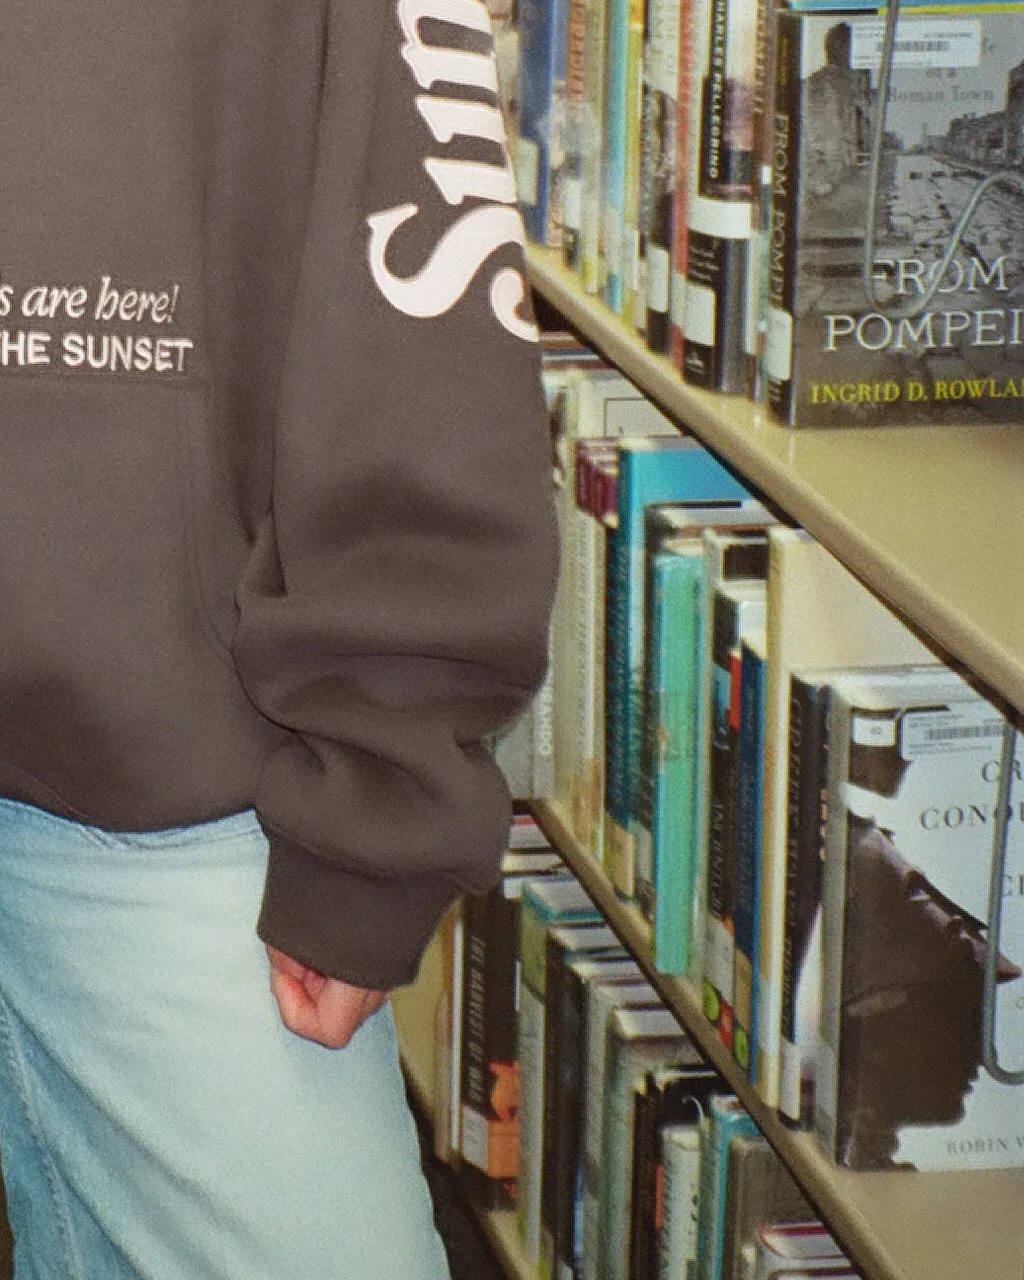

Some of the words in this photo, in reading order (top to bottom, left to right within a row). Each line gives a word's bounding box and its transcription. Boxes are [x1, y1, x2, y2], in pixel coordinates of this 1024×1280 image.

[950, 85, 994, 102] Town
[708, 71, 723, 179] PELLEGRINO
[774, 113, 790, 197] FROM
[21, 284, 88, 319] are
[94, 275, 181, 323] here!
[61, 333, 195, 372] SUNSET
[810, 381, 900, 404] INGRID
[907, 380, 929, 402] D.
[470, 934, 487, 968] THE
[468, 968, 487, 1043] HARVEST
[468, 1040, 484, 1064] OF
[467, 1065, 484, 1105] WAR
[945, 1138, 1009, 1155] ROBIN
